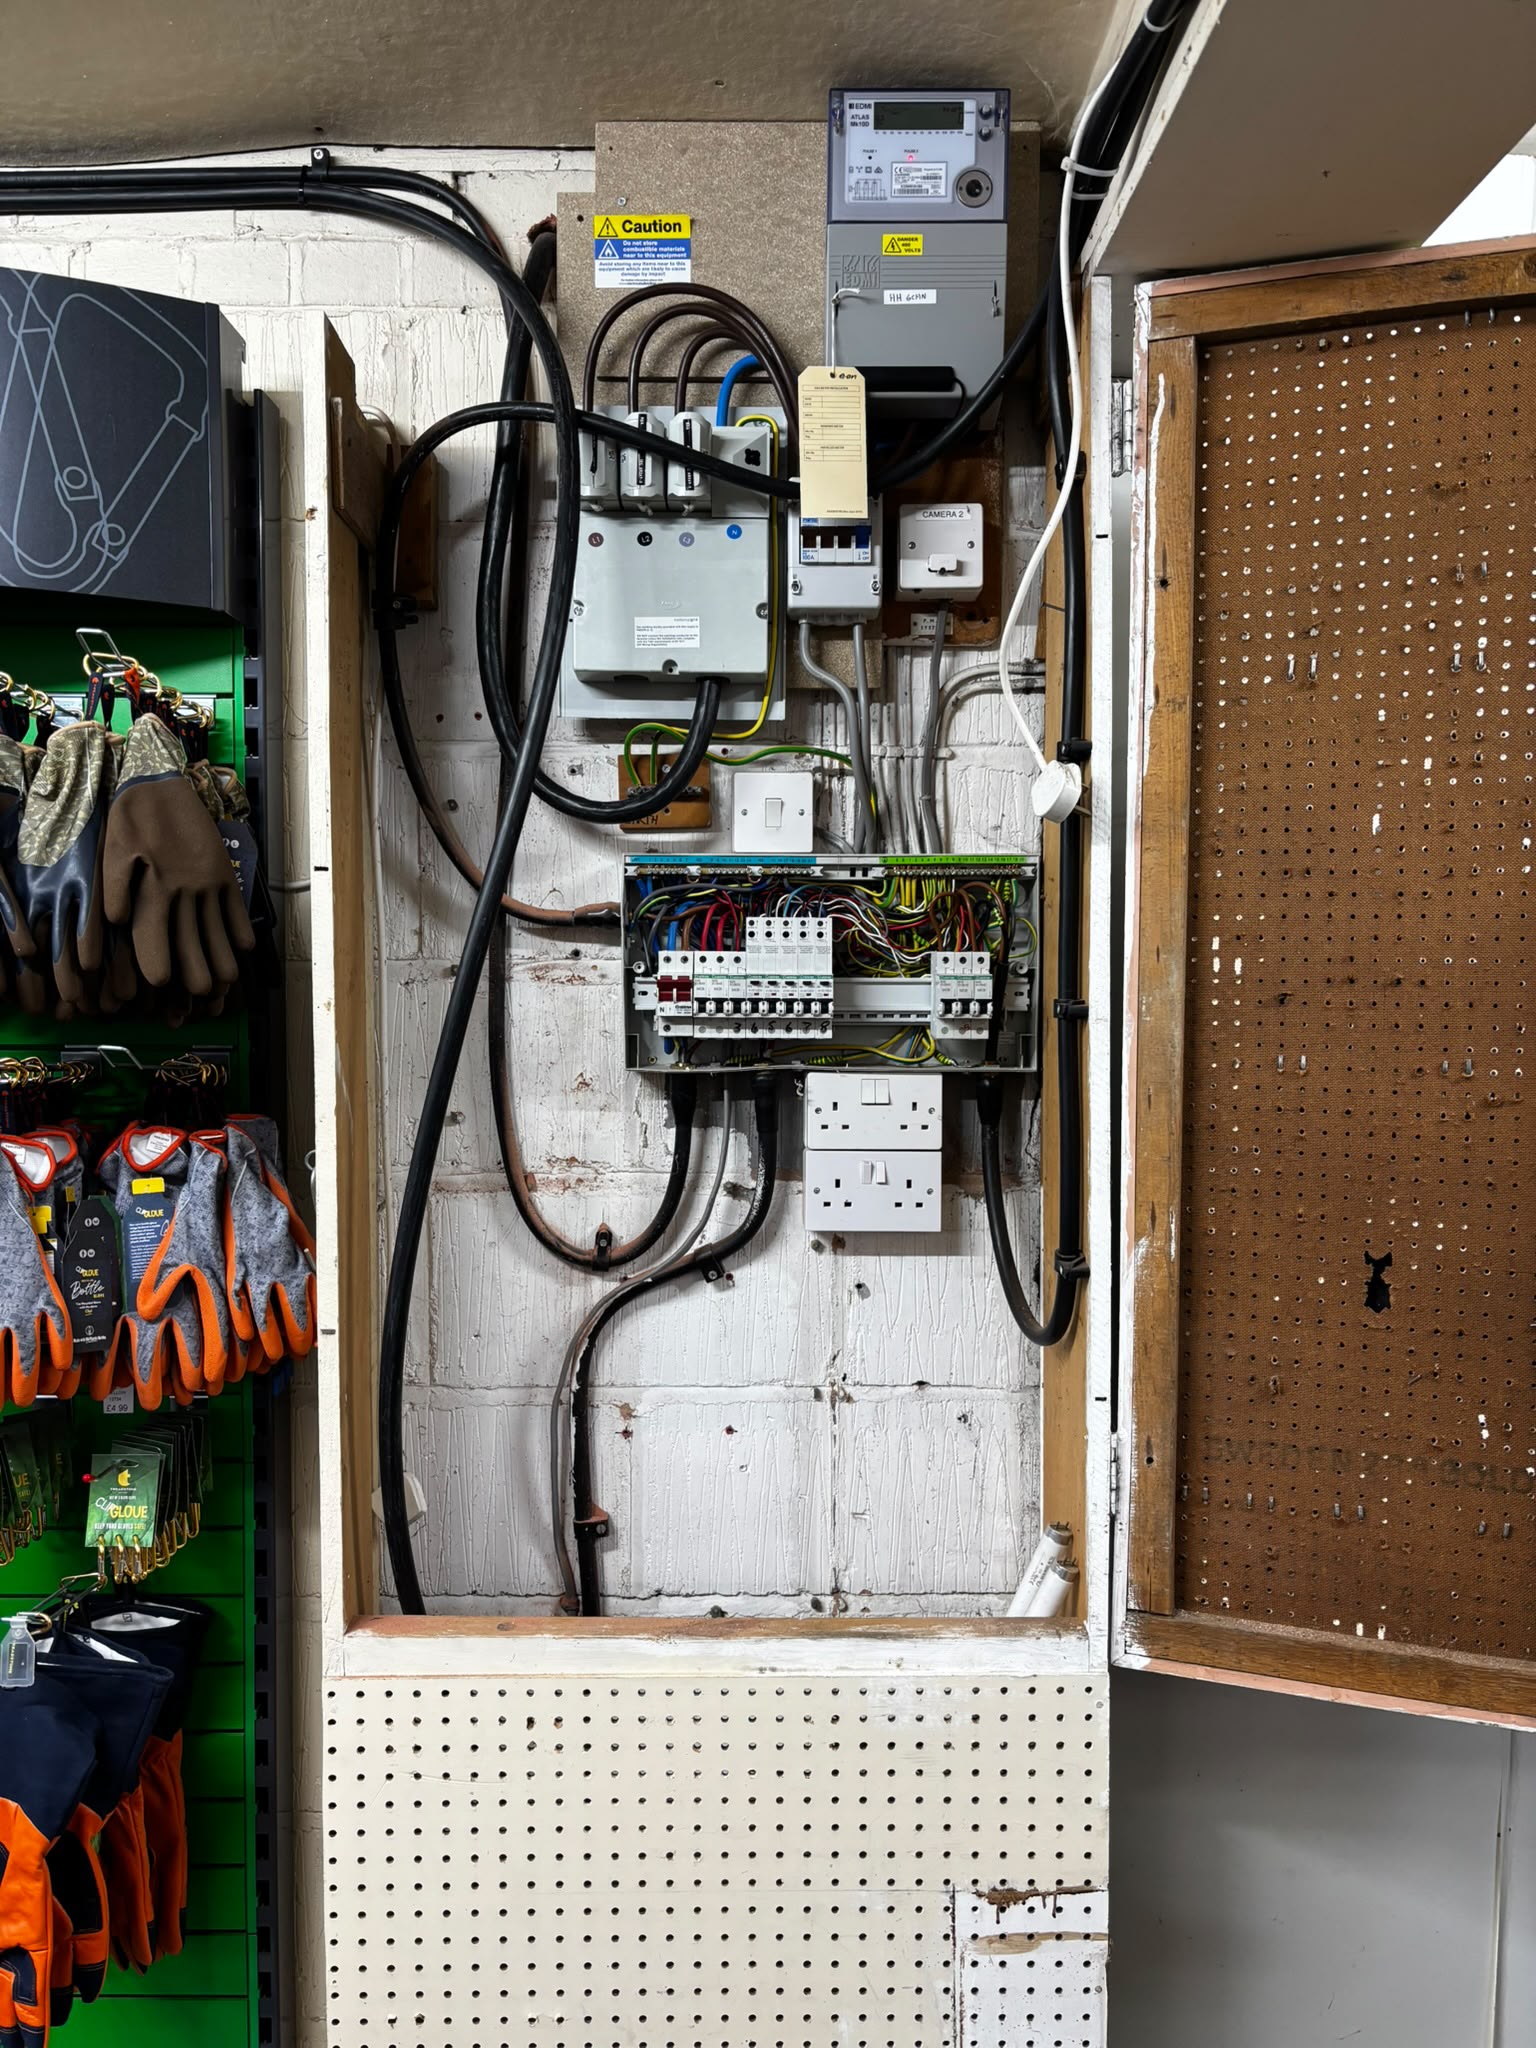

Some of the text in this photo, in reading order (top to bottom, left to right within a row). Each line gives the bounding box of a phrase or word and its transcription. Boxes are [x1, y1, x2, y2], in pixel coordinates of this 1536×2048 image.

[622, 219, 682, 233] Caution
[844, 273, 878, 288] EDMI
[889, 293, 903, 302] HH
[592, 536, 601, 544] L1
[641, 535, 650, 543] L2
[734, 1022, 741, 1032] 3
[768, 1021, 776, 1031] 5
[785, 1022, 793, 1032] 6
[820, 1021, 830, 1032] 8
[70, 1280, 105, 1300] Bottle
[95, 1497, 115, 1512] CLIP
